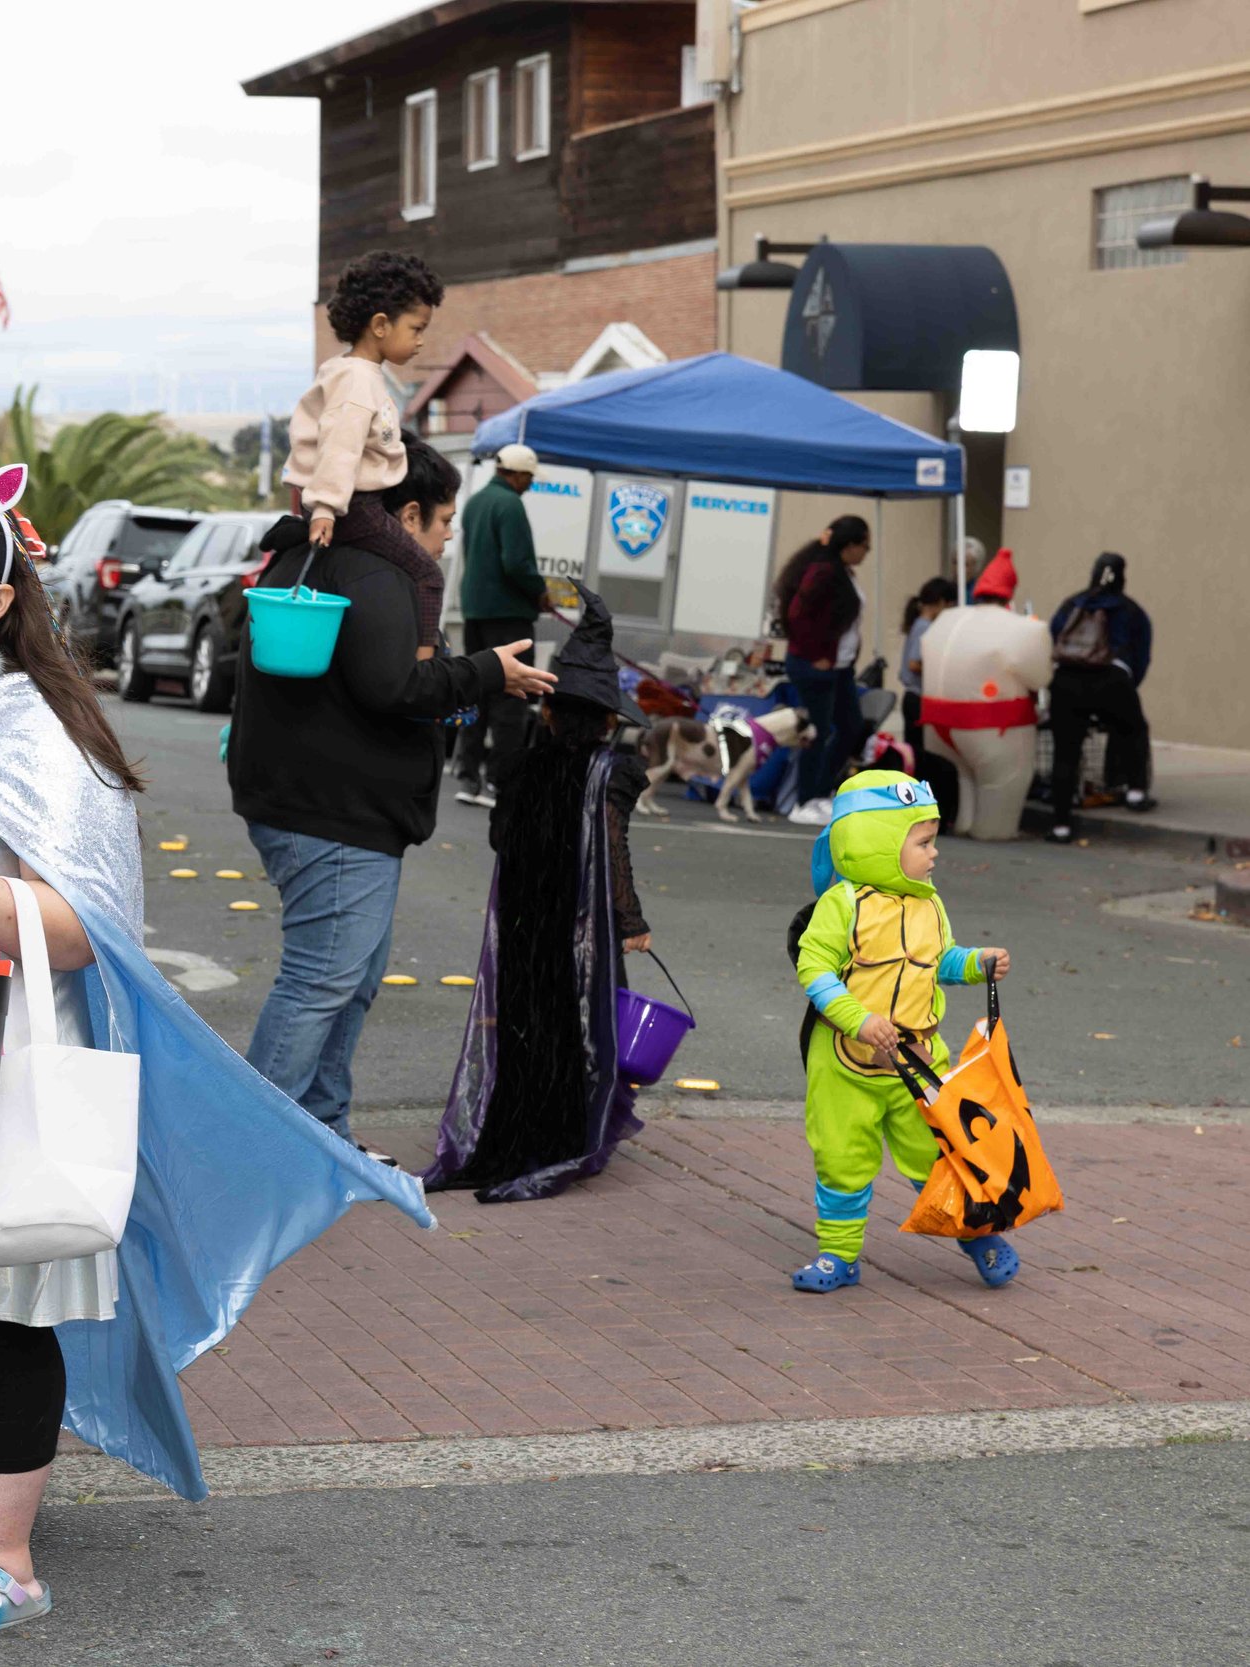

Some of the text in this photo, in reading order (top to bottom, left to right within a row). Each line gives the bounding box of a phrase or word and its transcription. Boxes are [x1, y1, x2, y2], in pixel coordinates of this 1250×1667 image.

[529, 482, 581, 497] NIMAL
[690, 496, 769, 515] SERVICES
[537, 557, 584, 575] TION
